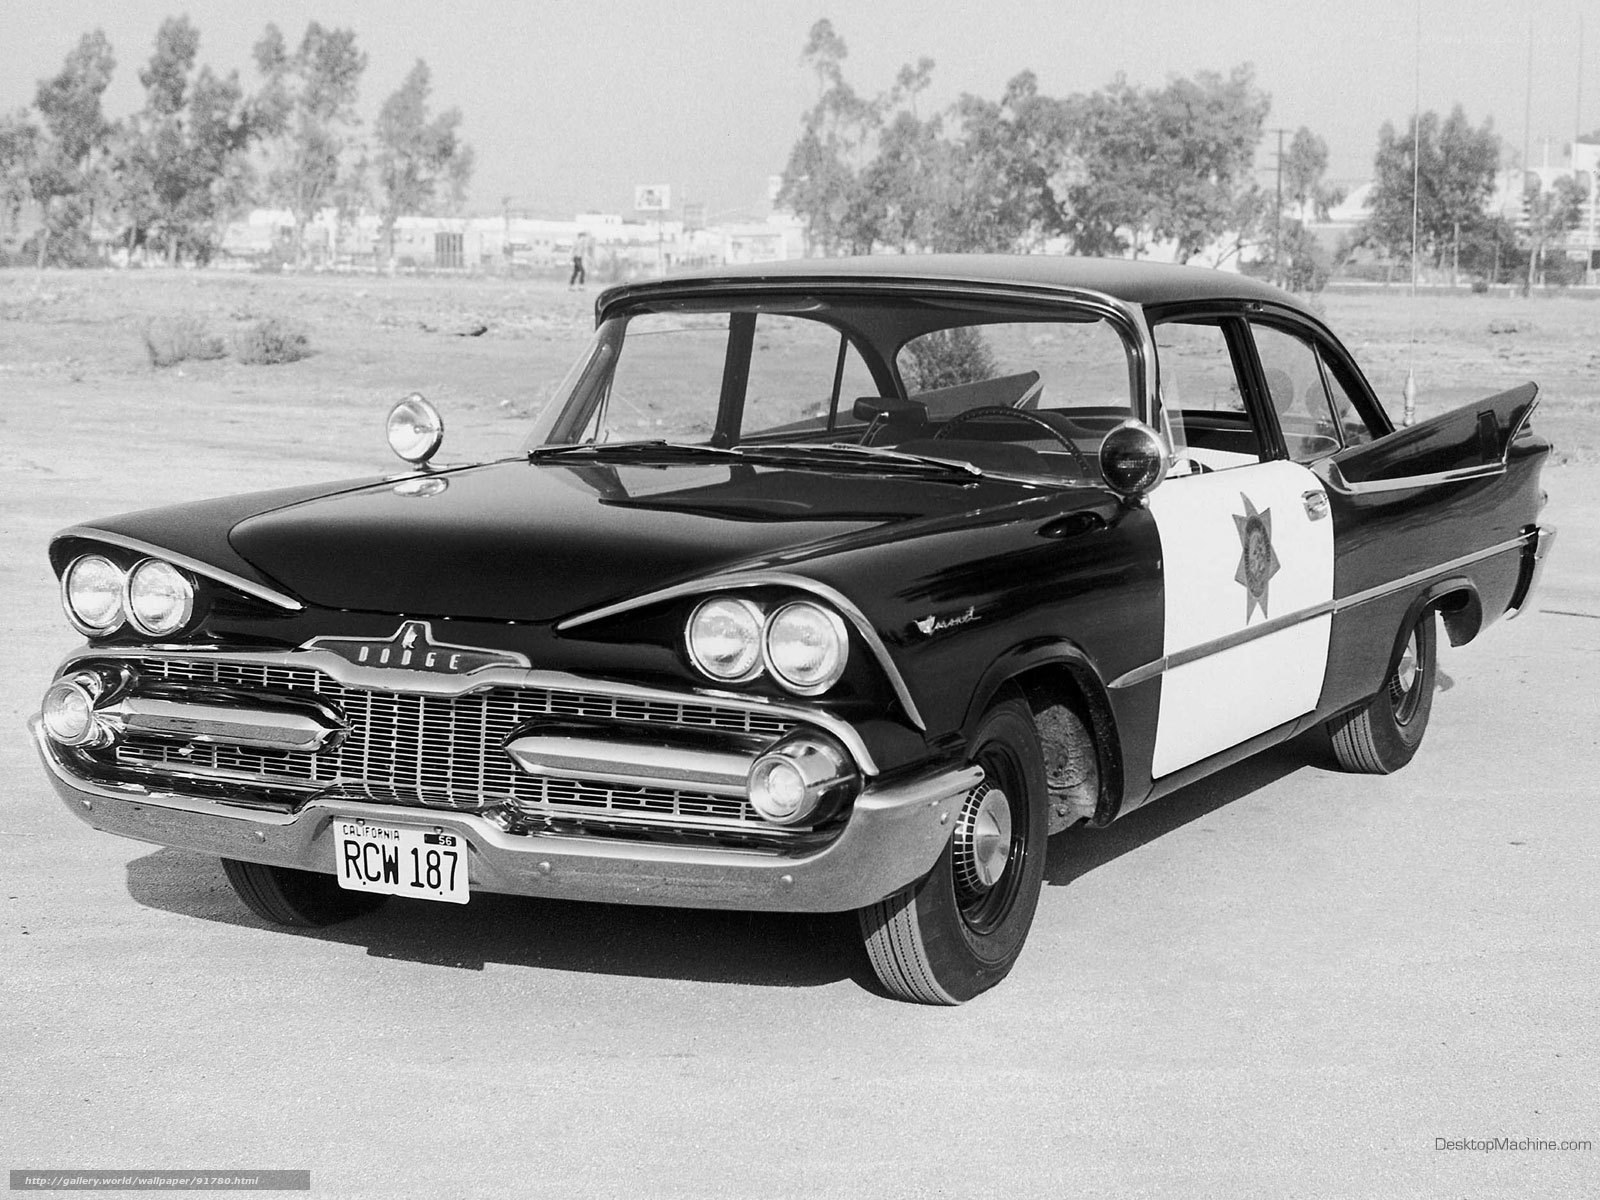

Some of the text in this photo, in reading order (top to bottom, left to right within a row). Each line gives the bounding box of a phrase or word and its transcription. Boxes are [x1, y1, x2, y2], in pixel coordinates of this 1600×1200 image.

[358, 646, 461, 670] DODGE
[342, 824, 400, 840] CALIFORNIA
[438, 835, 453, 846] 56
[344, 839, 458, 891] RCW 187
